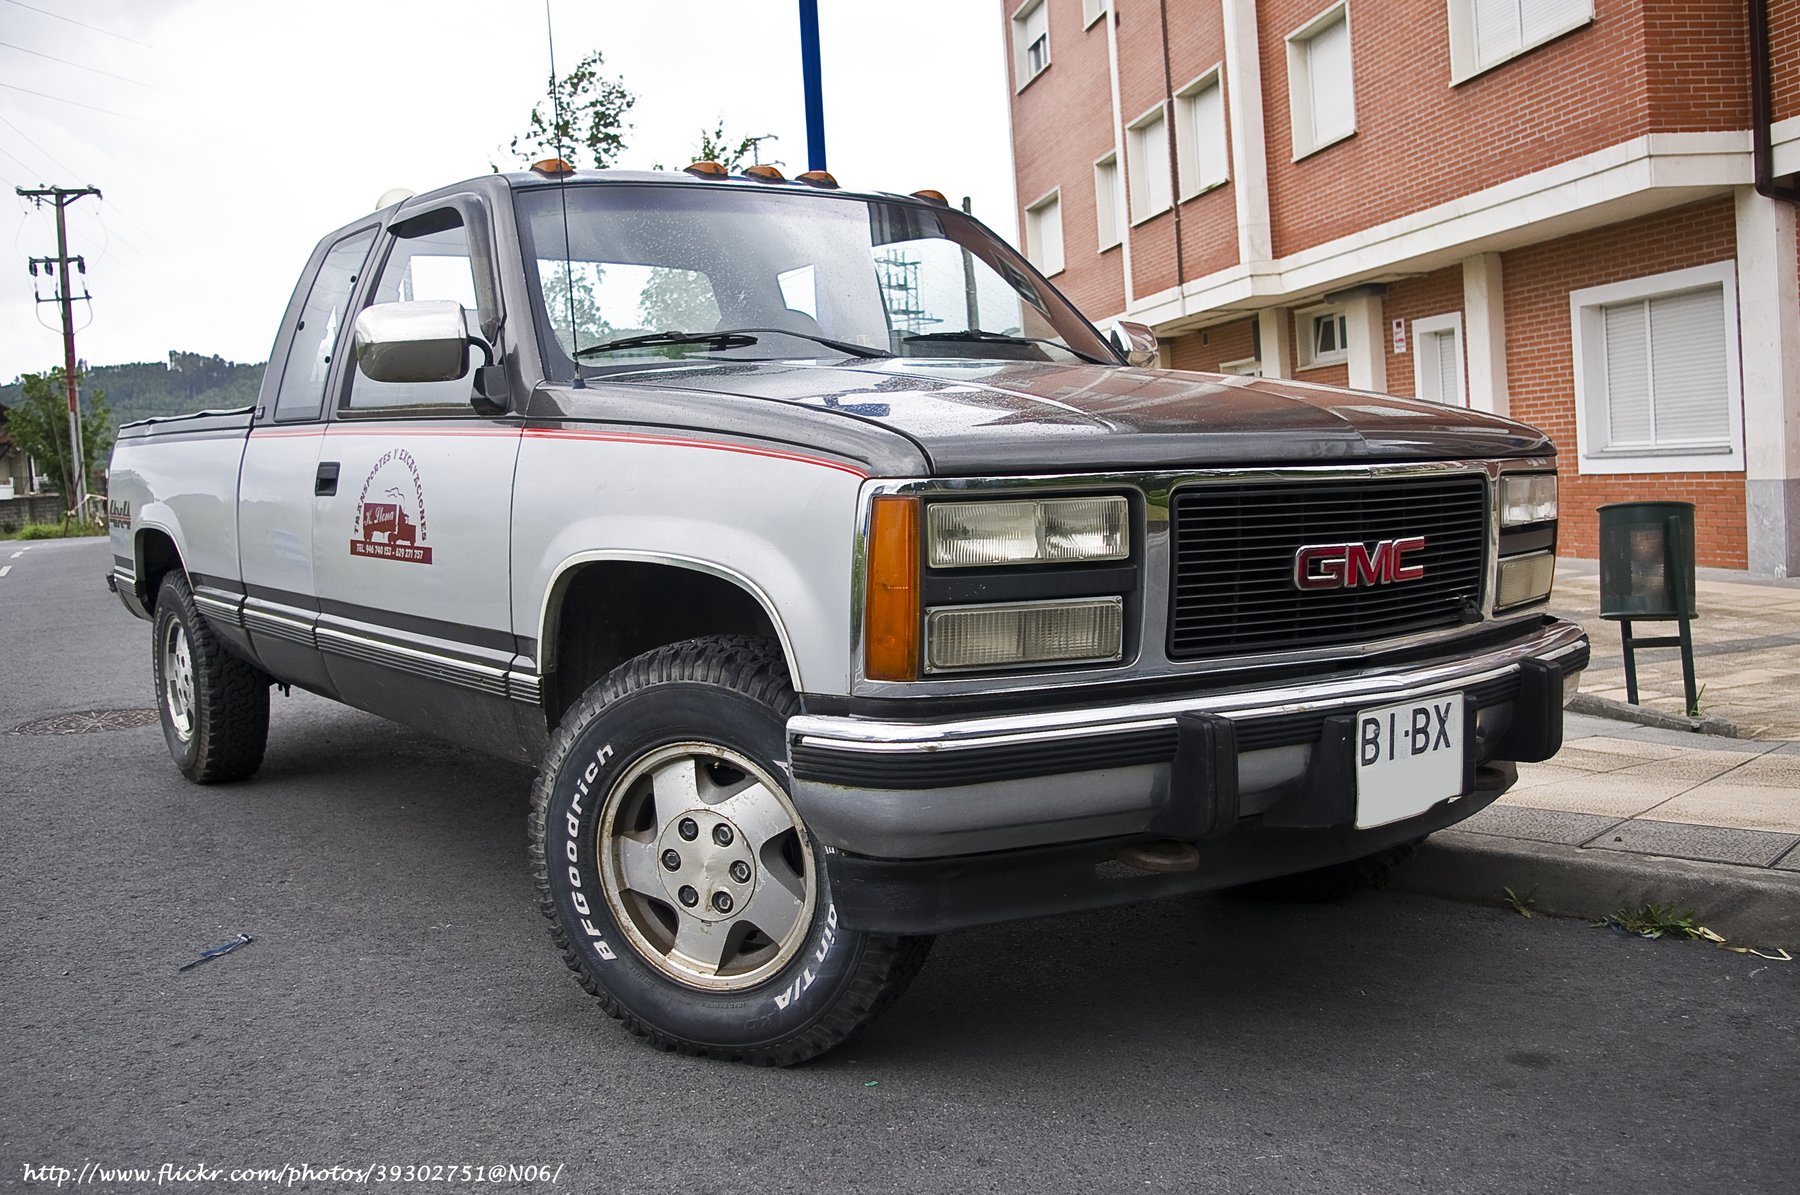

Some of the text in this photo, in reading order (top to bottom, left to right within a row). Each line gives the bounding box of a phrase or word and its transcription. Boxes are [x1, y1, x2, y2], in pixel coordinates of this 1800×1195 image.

[354, 448, 427, 541] TRANSPORTES Y EXCAVACIONES
[1294, 535, 1425, 591] GMC
[566, 744, 618, 961] BFGoodrich
[774, 968, 816, 1010] T/A
